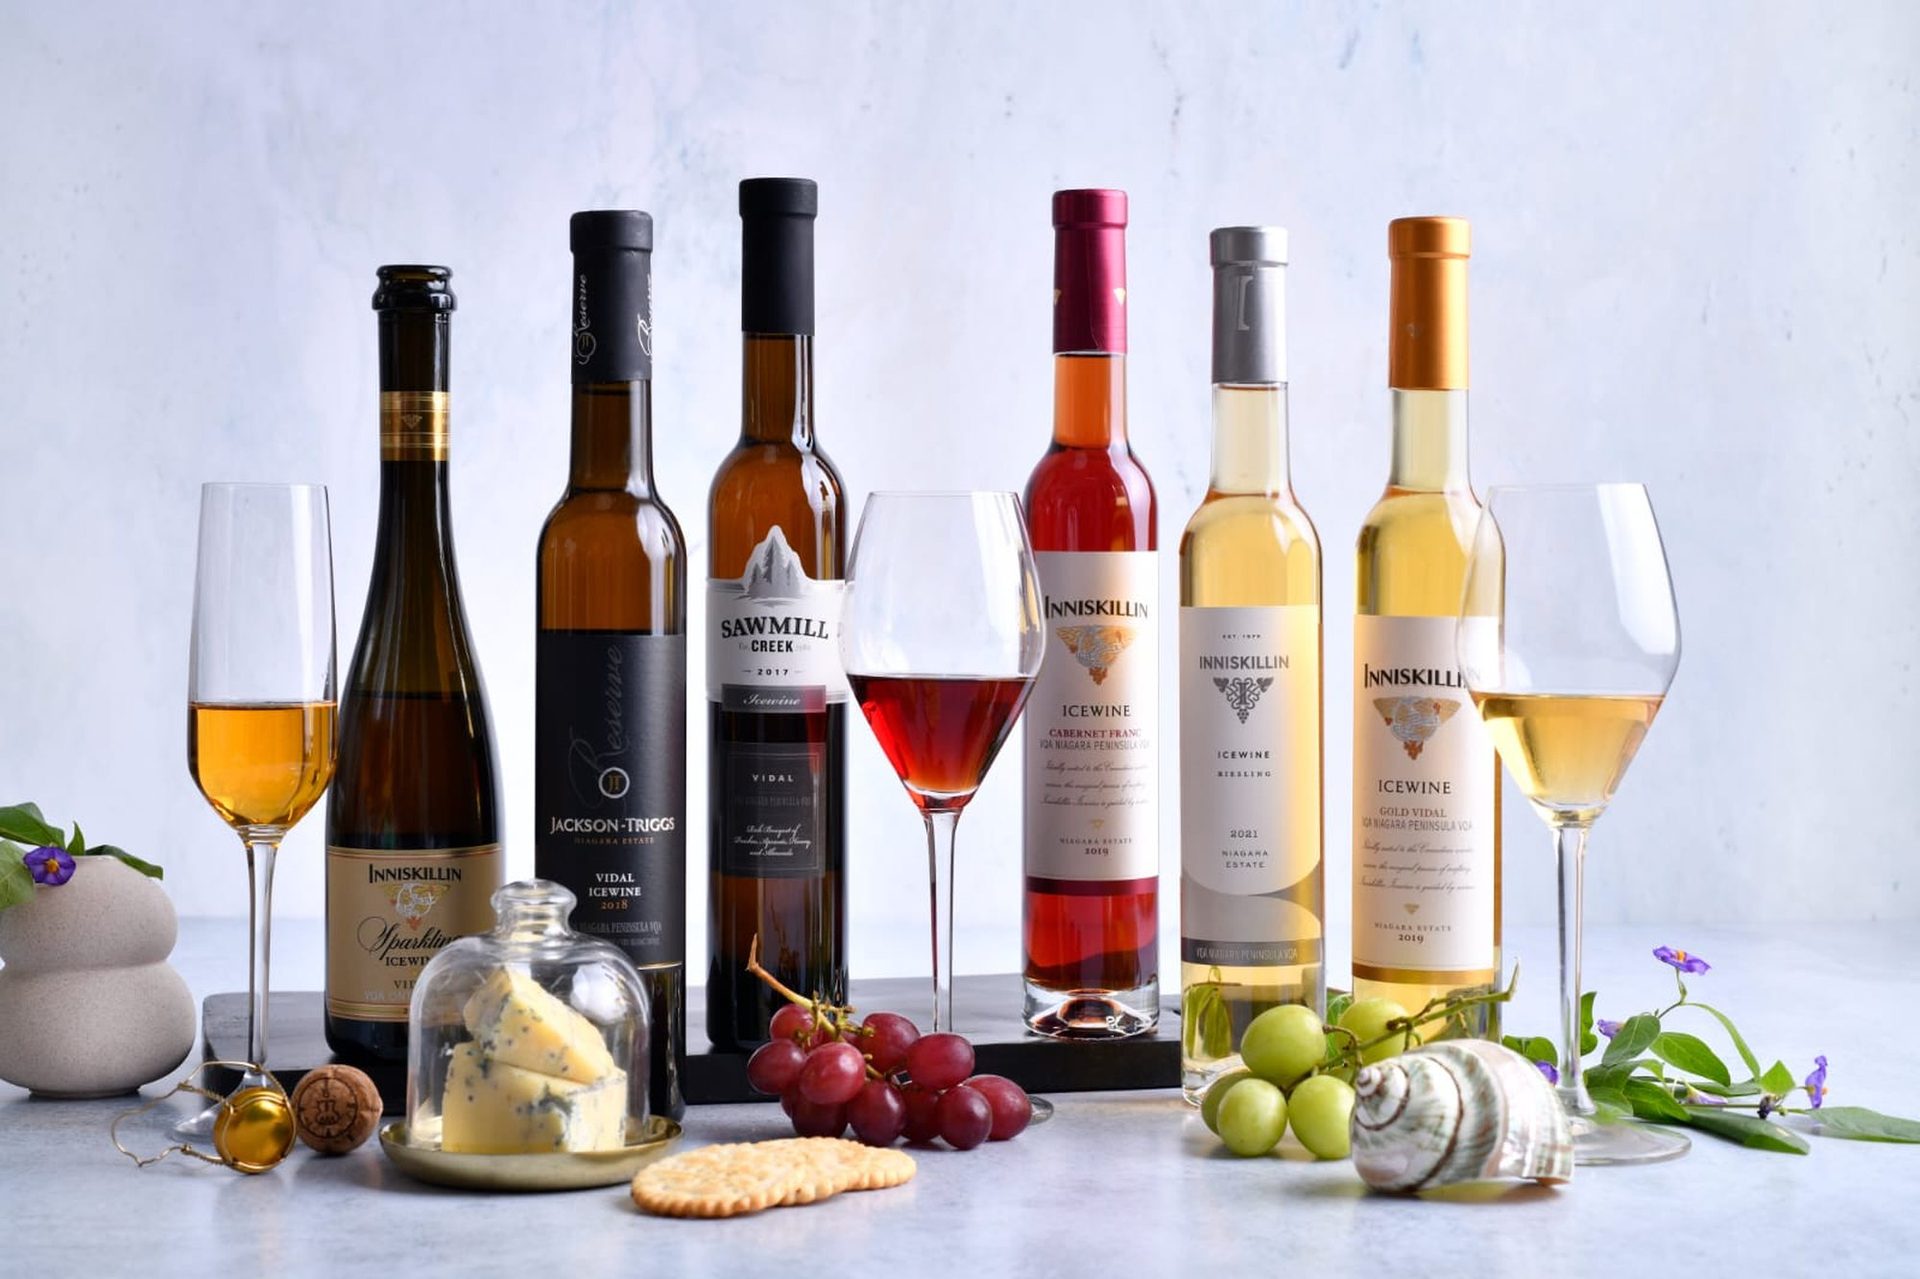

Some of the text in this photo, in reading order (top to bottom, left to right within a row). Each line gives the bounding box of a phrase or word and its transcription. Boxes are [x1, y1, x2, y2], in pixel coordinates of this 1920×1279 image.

[1044, 595, 1149, 619] INNISKILLIN
[721, 616, 829, 640] SAWMILL
[751, 640, 793, 652] CREEK
[1199, 656, 1290, 669] INNISKILLIN
[757, 668, 789, 676] 2017
[743, 695, 801, 706] Icewine
[1062, 704, 1132, 717] ICEWINE
[1049, 728, 1142, 738] CABERNET FRANC
[1217, 751, 1271, 759] ICEWINE
[752, 774, 794, 782] VIDAL
[1378, 780, 1452, 795] ICEWINE
[1379, 806, 1448, 818] GOLD VIDAL
[550, 816, 675, 835] JACKSON-TRIGGS
[1230, 830, 1259, 839] 2021
[1084, 847, 1109, 856] 2019
[1225, 861, 1265, 869] ESTATE
[369, 864, 462, 884] INNISKILLIN
[596, 873, 635, 883] VIDAL
[589, 887, 641, 897] ICEWINE
[601, 900, 628, 910] 2018
[357, 916, 465, 961] Sparklin
[1398, 934, 1424, 943] 2019
